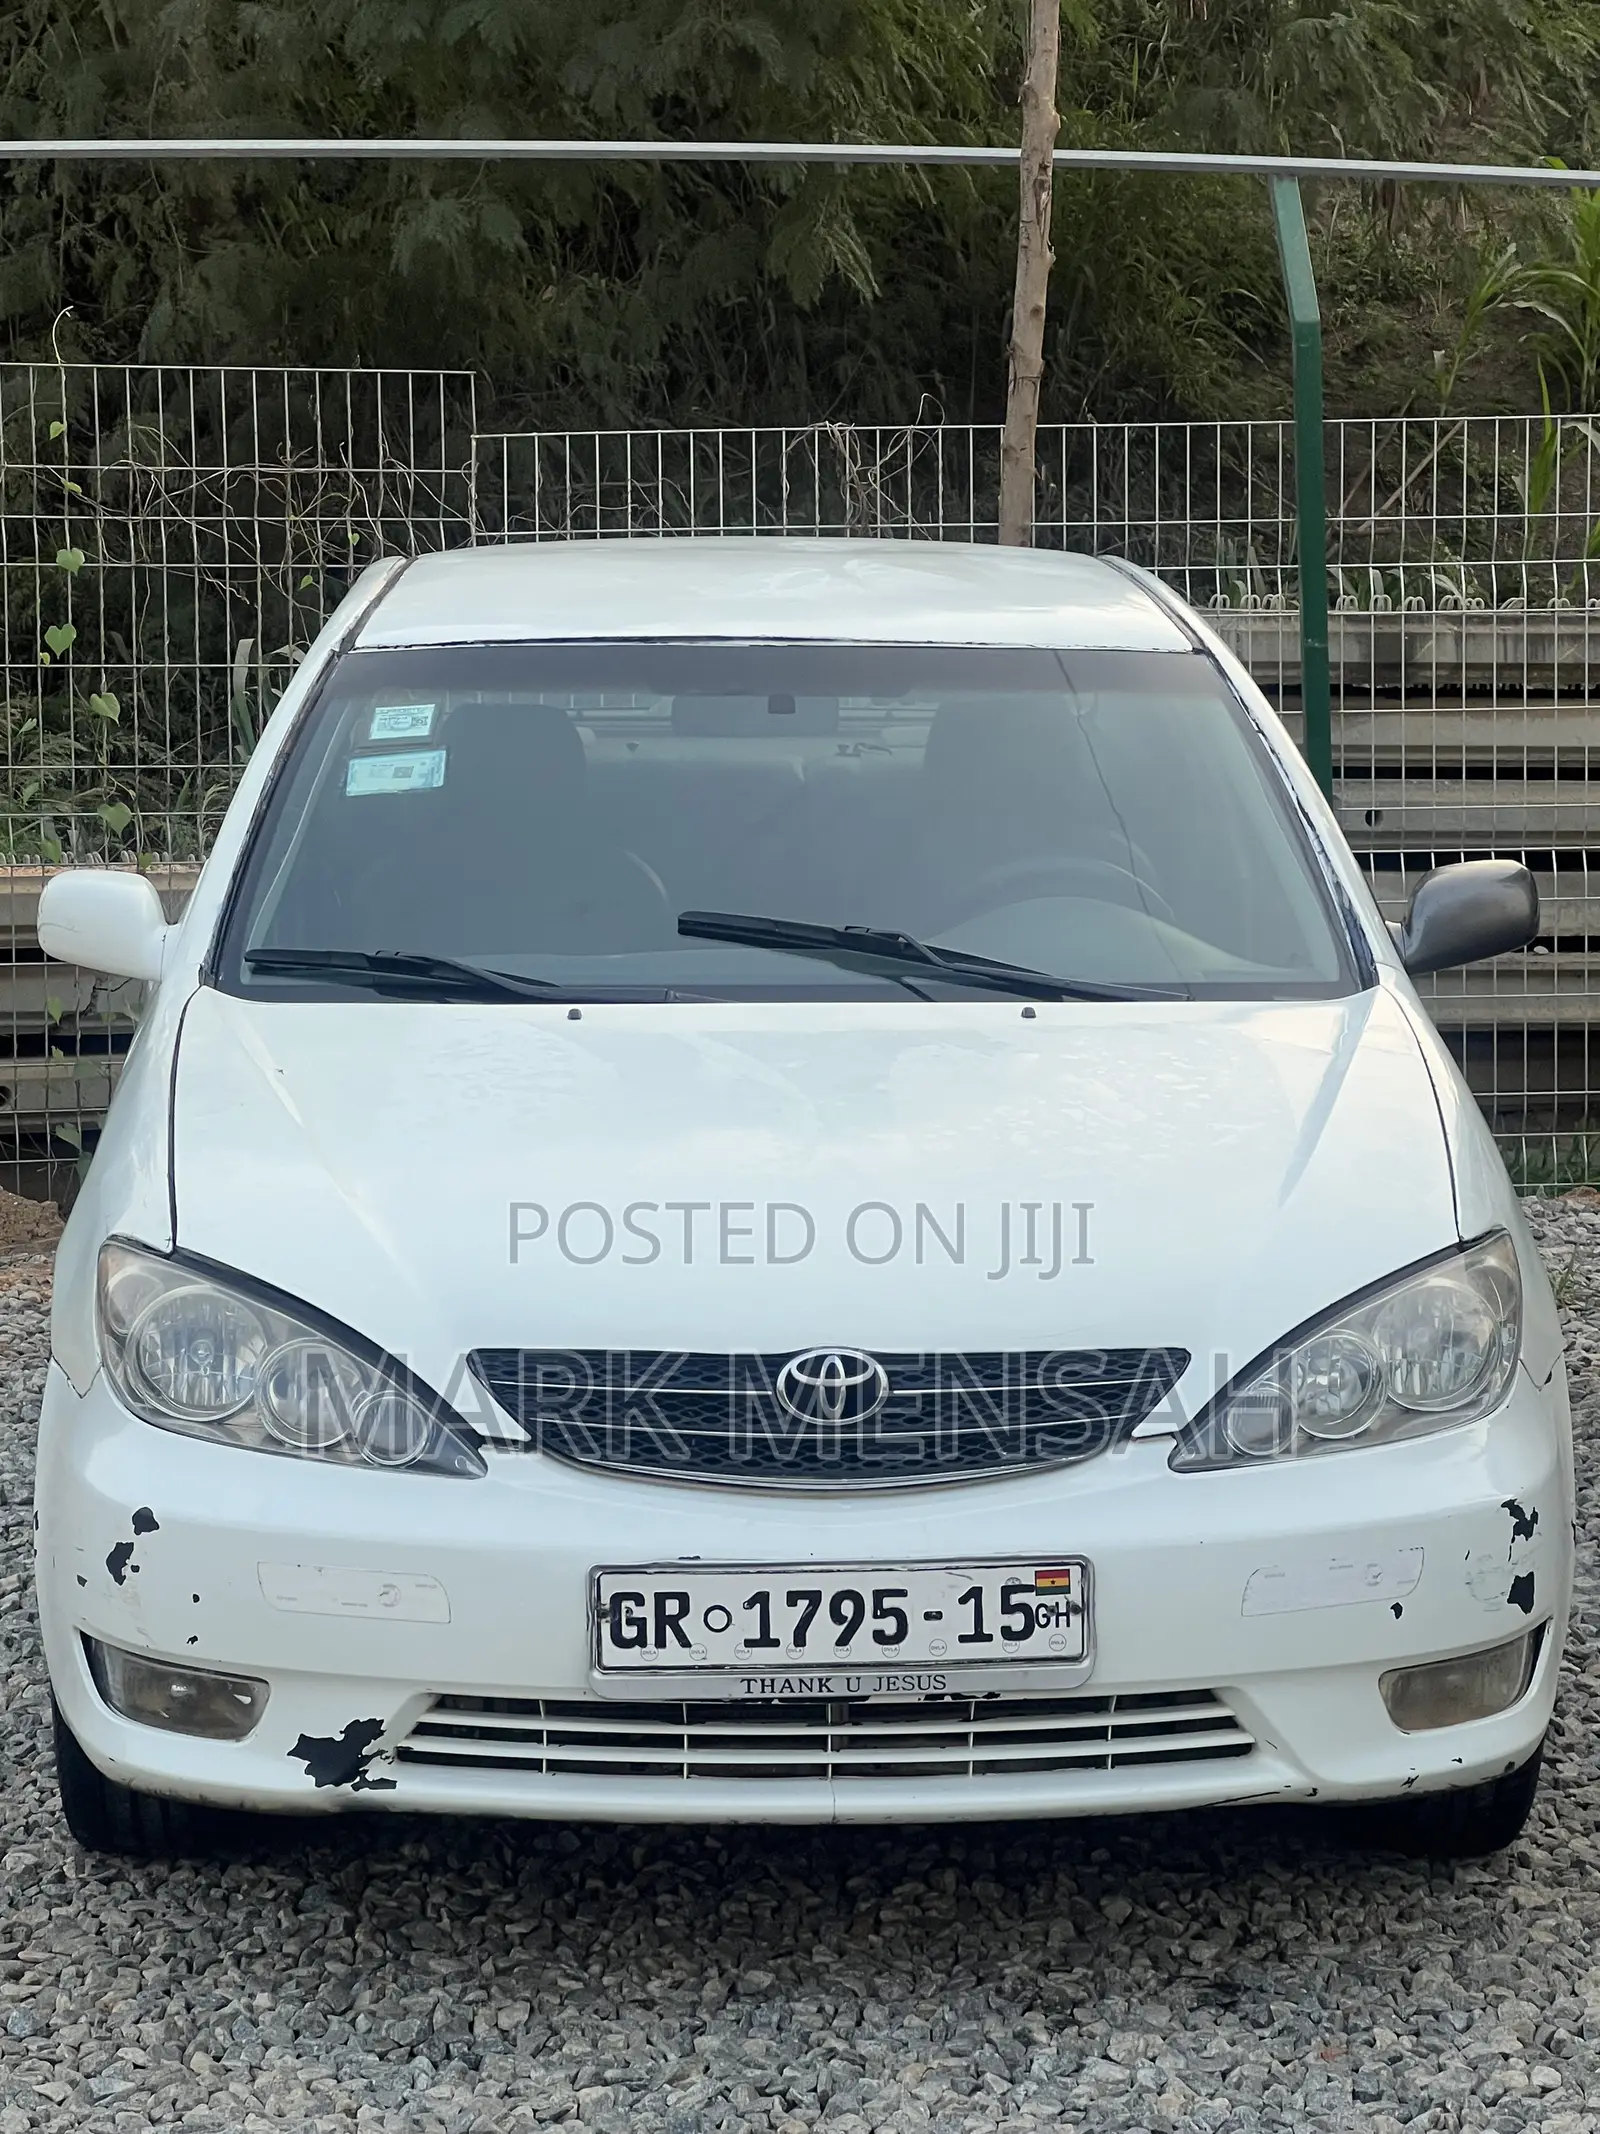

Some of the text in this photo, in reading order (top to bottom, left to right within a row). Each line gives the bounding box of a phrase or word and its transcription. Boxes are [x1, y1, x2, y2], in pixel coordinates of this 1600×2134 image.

[609, 1591, 692, 1649] GR
[1034, 1601, 1071, 1629] GH
[740, 1674, 947, 1694] THANK U JESUS
